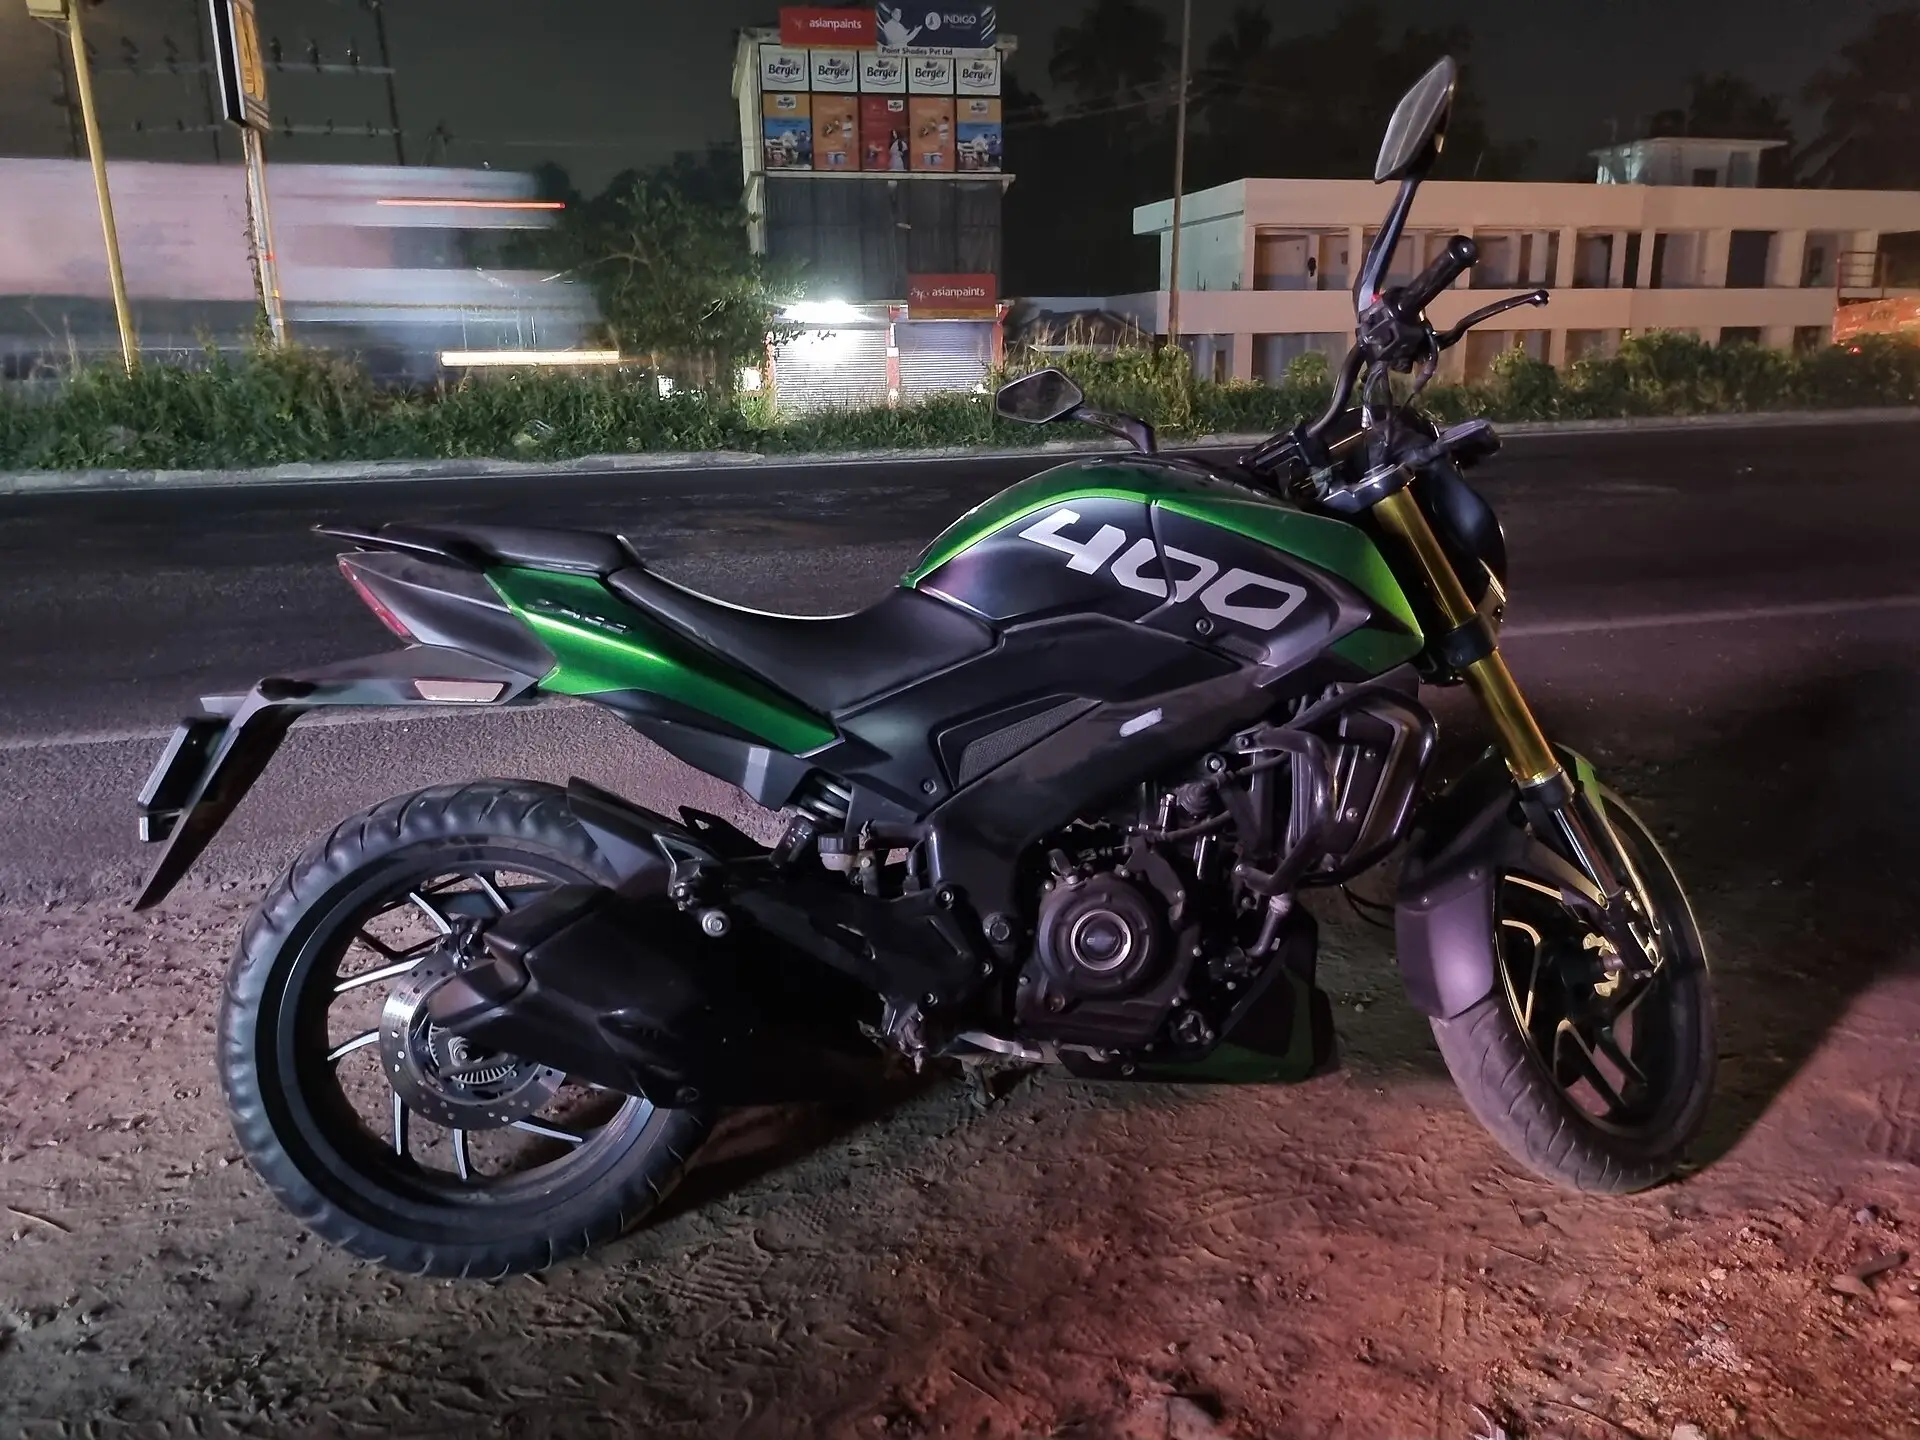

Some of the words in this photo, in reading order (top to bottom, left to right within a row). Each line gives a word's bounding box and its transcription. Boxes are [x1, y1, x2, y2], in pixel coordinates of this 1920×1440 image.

[809, 18, 861, 32] asianpaints
[943, 14, 977, 25] INDIGO
[768, 63, 801, 78] Berger
[818, 65, 851, 79] Berger
[866, 66, 898, 80] Berger
[914, 67, 946, 80] Berger
[962, 68, 993, 80] Berger
[931, 286, 985, 298] asianpaints
[1018, 508, 1307, 631] 400
